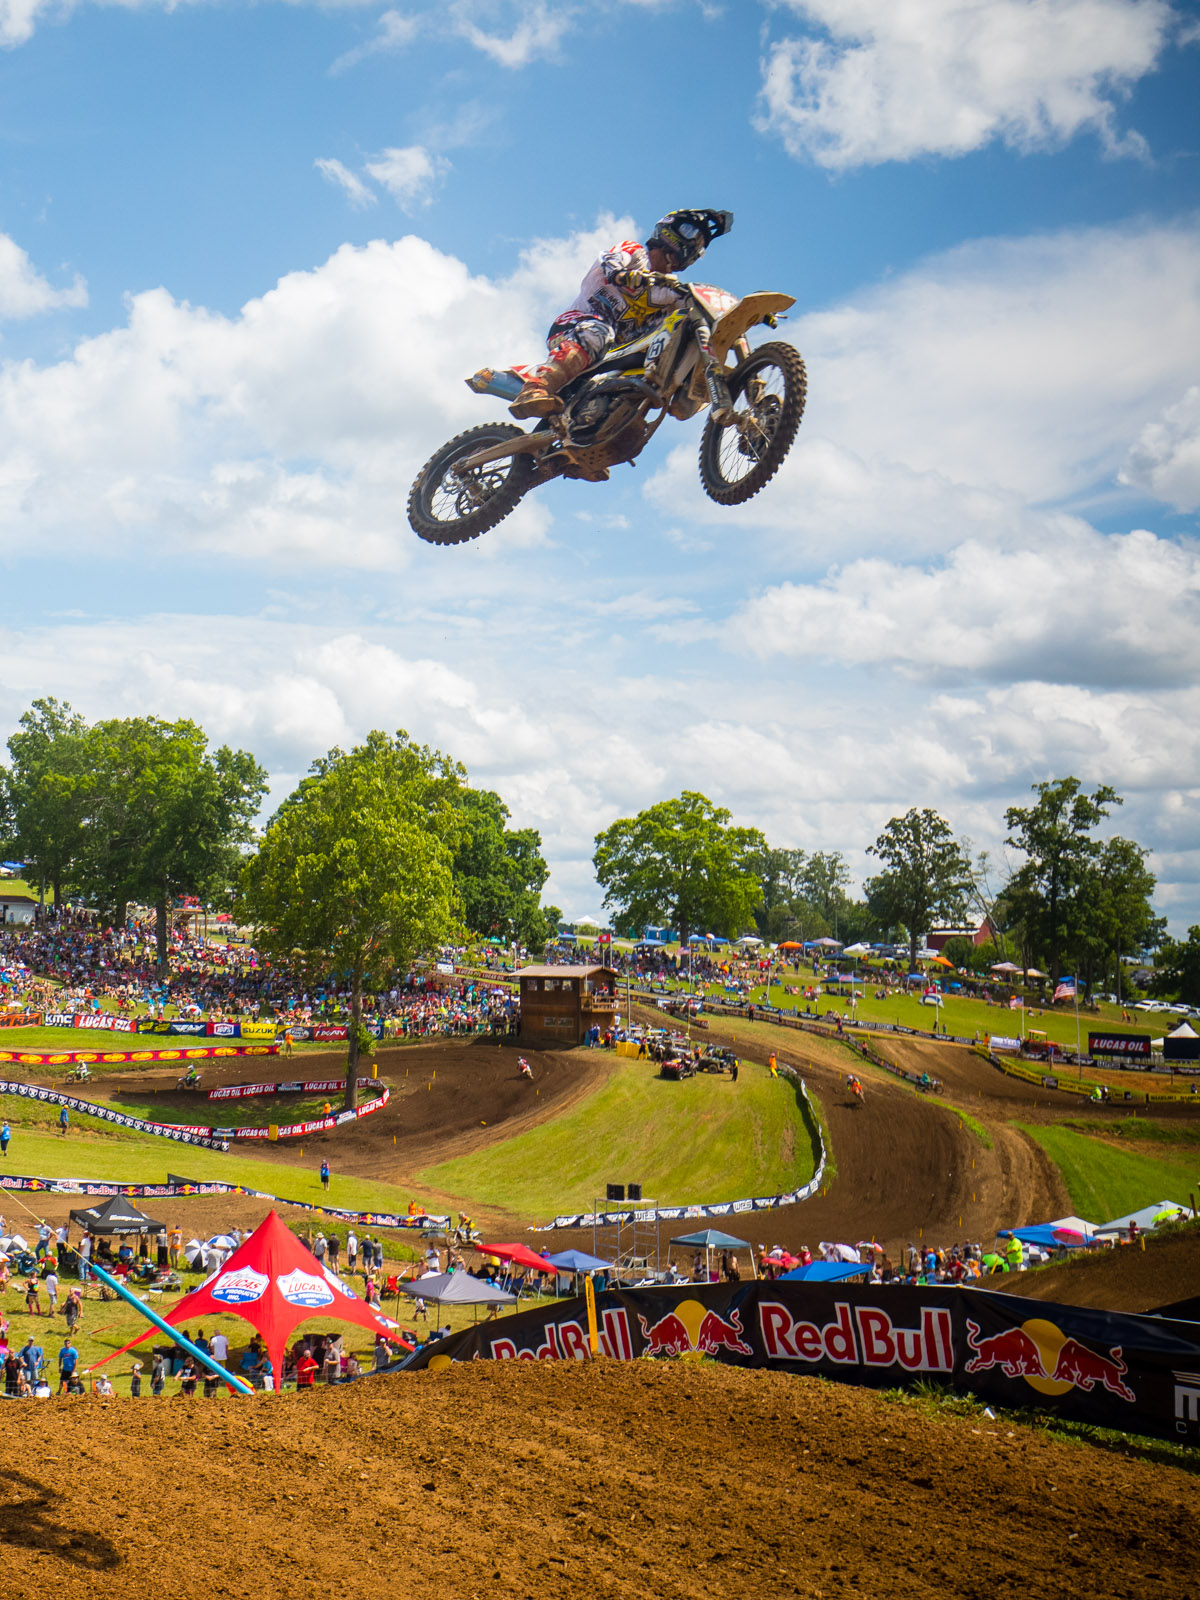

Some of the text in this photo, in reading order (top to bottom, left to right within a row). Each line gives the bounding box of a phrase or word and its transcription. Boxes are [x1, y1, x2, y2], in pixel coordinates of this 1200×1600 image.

[79, 1015, 113, 1028] LUCAS
[114, 1019, 132, 1031] OIL
[1093, 1038, 1144, 1052] LUCAS OIL
[304, 1082, 326, 1090] LUCAS
[328, 1081, 338, 1090] OIL
[209, 1089, 230, 1099] LUCAS
[231, 1088, 241, 1097] OIL
[243, 1087, 263, 1096] LUCAS
[264, 1084, 275, 1093] OIL
[304, 1120, 324, 1132] LUCAS
[237, 1128, 257, 1137] LUCAS
[7, 1178, 22, 1189] Bull
[87, 1185, 103, 1195] Red
[103, 1185, 118, 1195] Bull
[144, 1186, 158, 1196] Red
[220, 1278, 262, 1290] LUCAS
[288, 1284, 323, 1293] LUCAS
[225, 1289, 259, 1298] PRODUCTS
[759, 1302, 953, 1372] Red Bull
